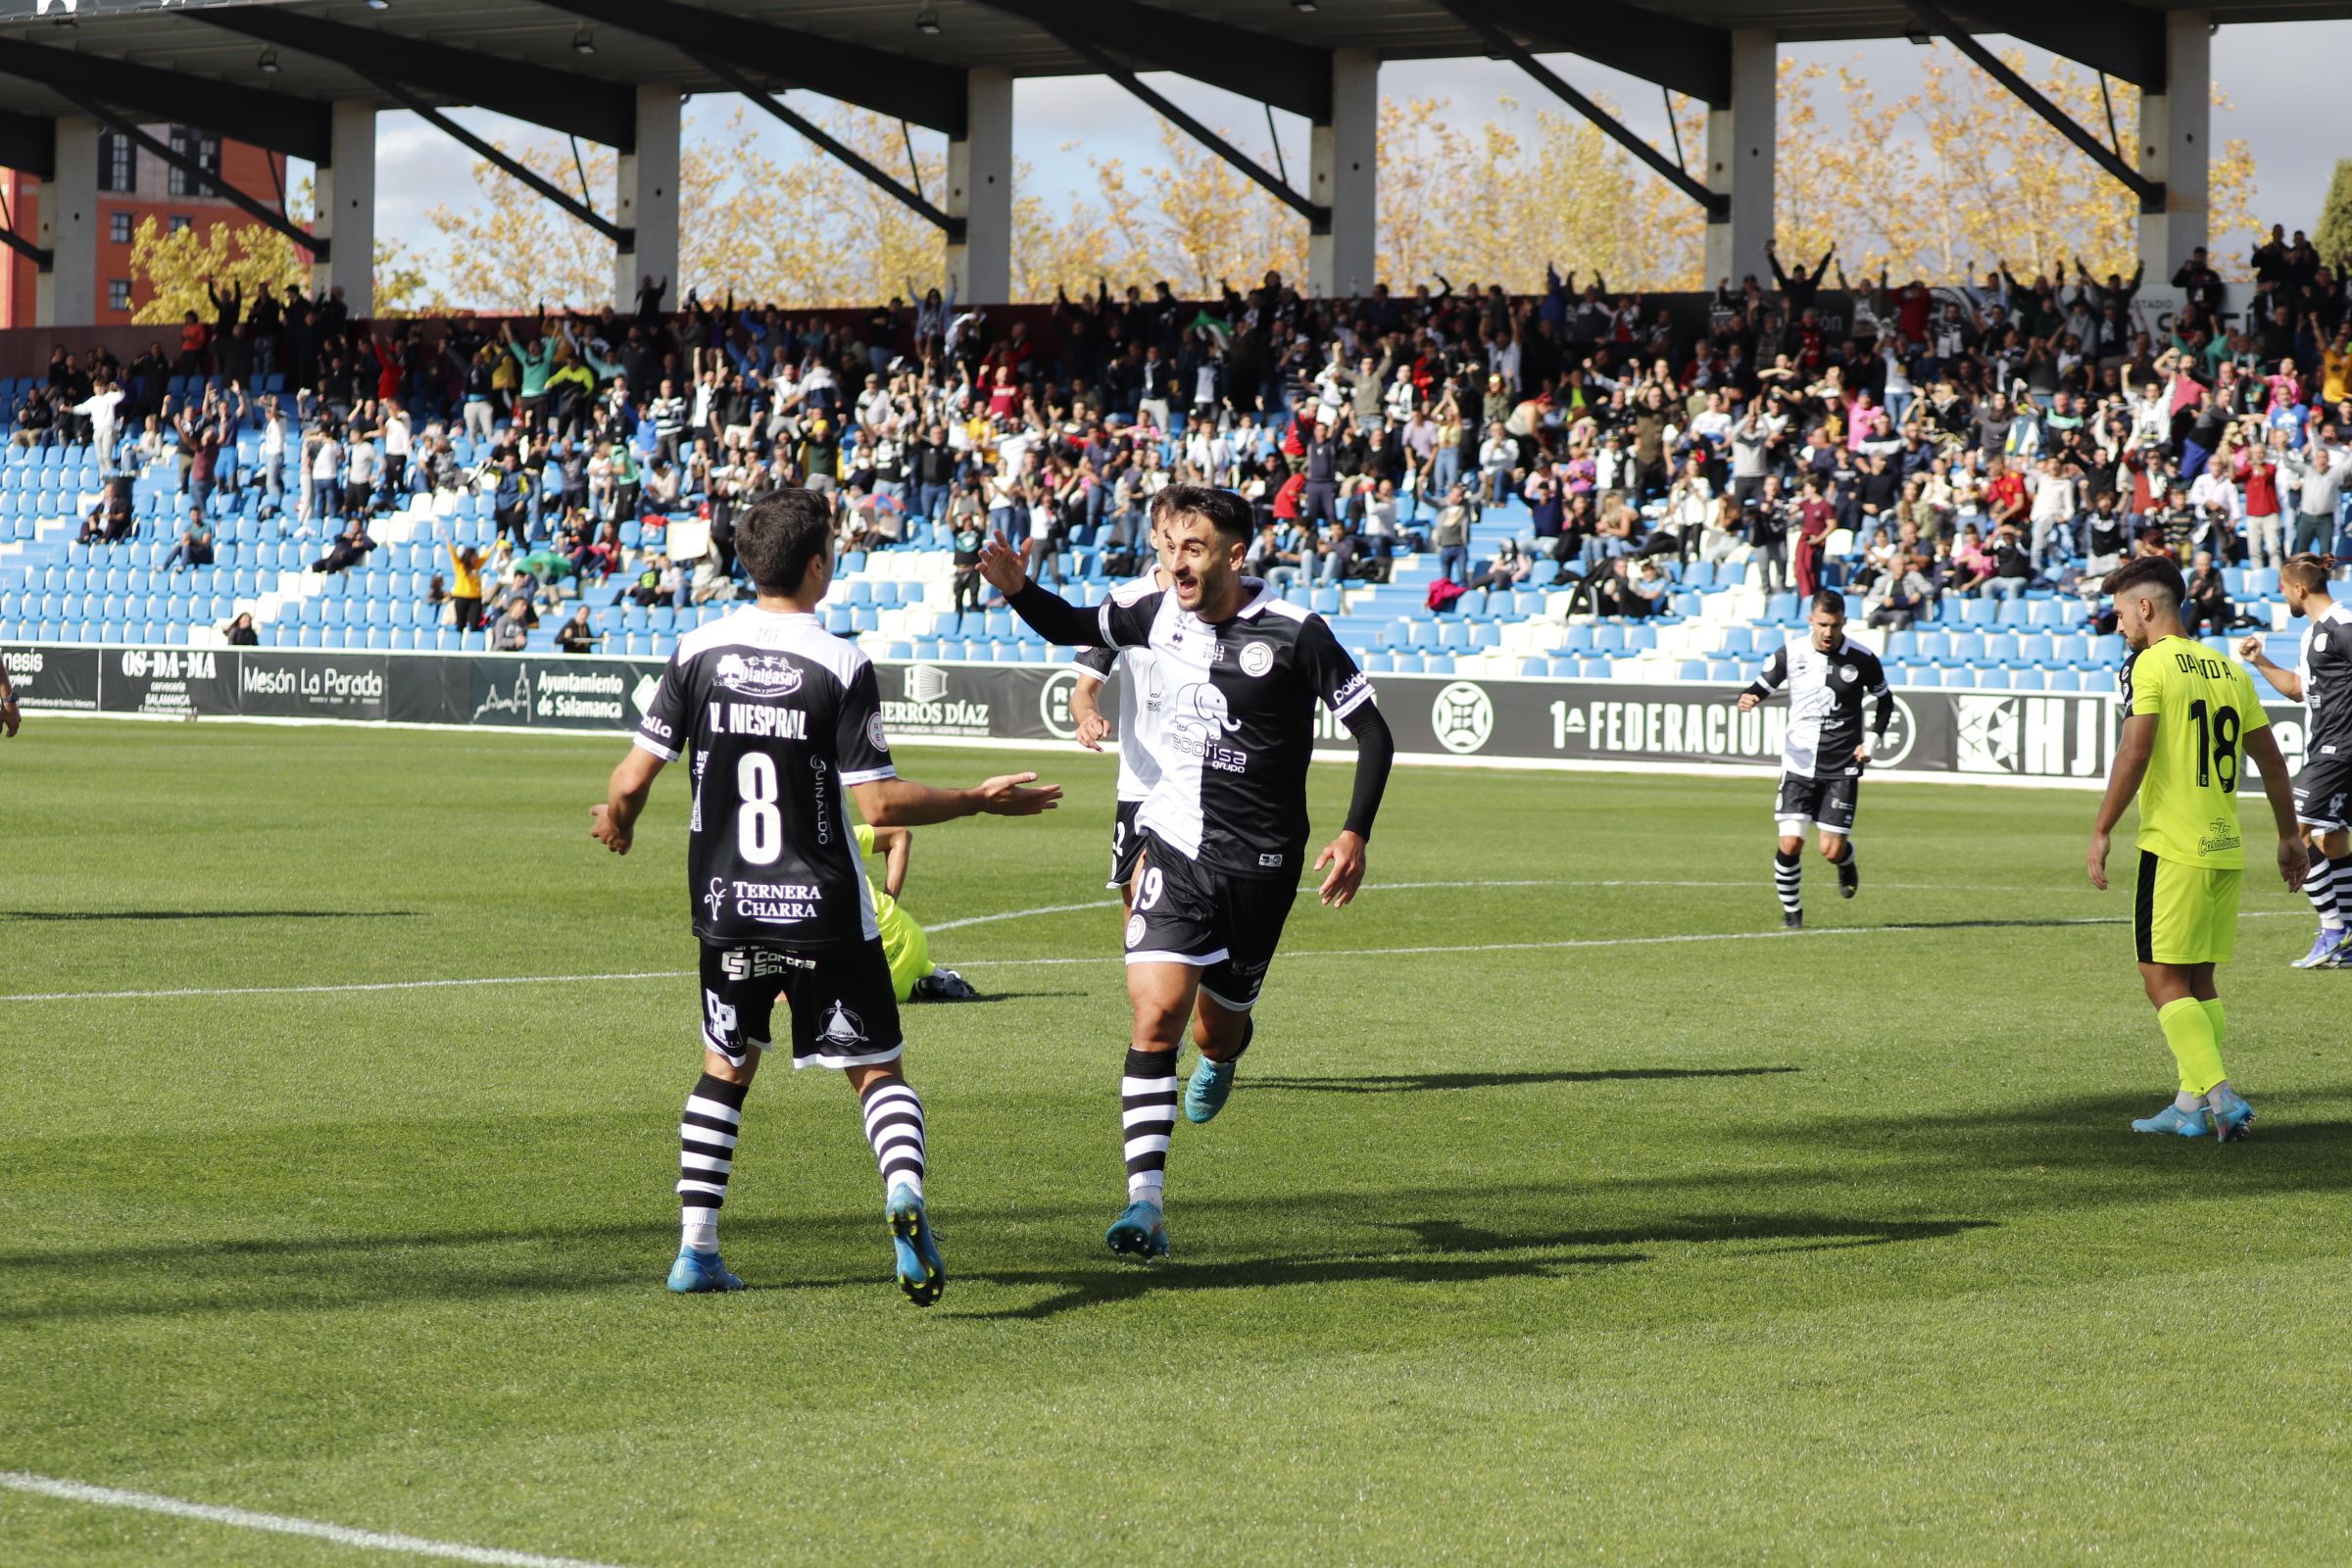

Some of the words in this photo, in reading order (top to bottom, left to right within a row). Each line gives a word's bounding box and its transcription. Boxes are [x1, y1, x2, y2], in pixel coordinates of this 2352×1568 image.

[0, 648, 43, 672] nesis
[122, 650, 217, 679] OS-DA-MA
[244, 666, 296, 694] Mesón
[300, 667, 320, 695] La
[324, 667, 383, 697] Parada
[537, 670, 623, 696] Ayuntamiento
[537, 694, 554, 716] de
[555, 695, 623, 719] Salamanca
[945, 699, 990, 725] DÍAZ
[729, 703, 808, 740] NESPRAL
[2188, 698, 2240, 794] 18
[1211, 760, 1246, 774] grupo
[737, 751, 782, 864] 8
[733, 882, 822, 900] TERNERA
[1131, 866, 1163, 910] 19
[737, 900, 817, 917] CHARRA
